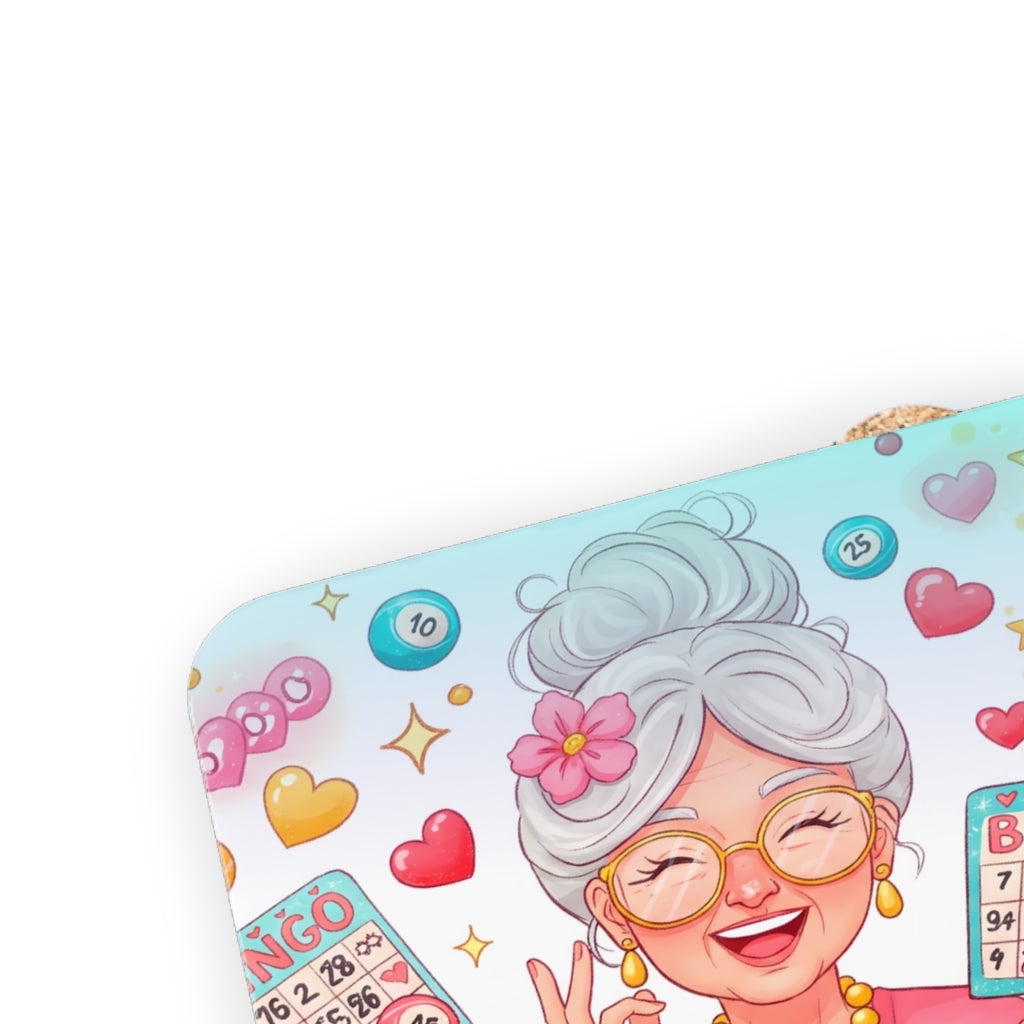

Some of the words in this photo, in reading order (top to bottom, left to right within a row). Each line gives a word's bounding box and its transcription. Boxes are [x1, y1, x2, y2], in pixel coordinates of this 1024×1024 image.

[843, 533, 872, 561] 25
[409, 611, 438, 638] 10
[997, 870, 1013, 890] 7
[293, 982, 320, 1006] 2
